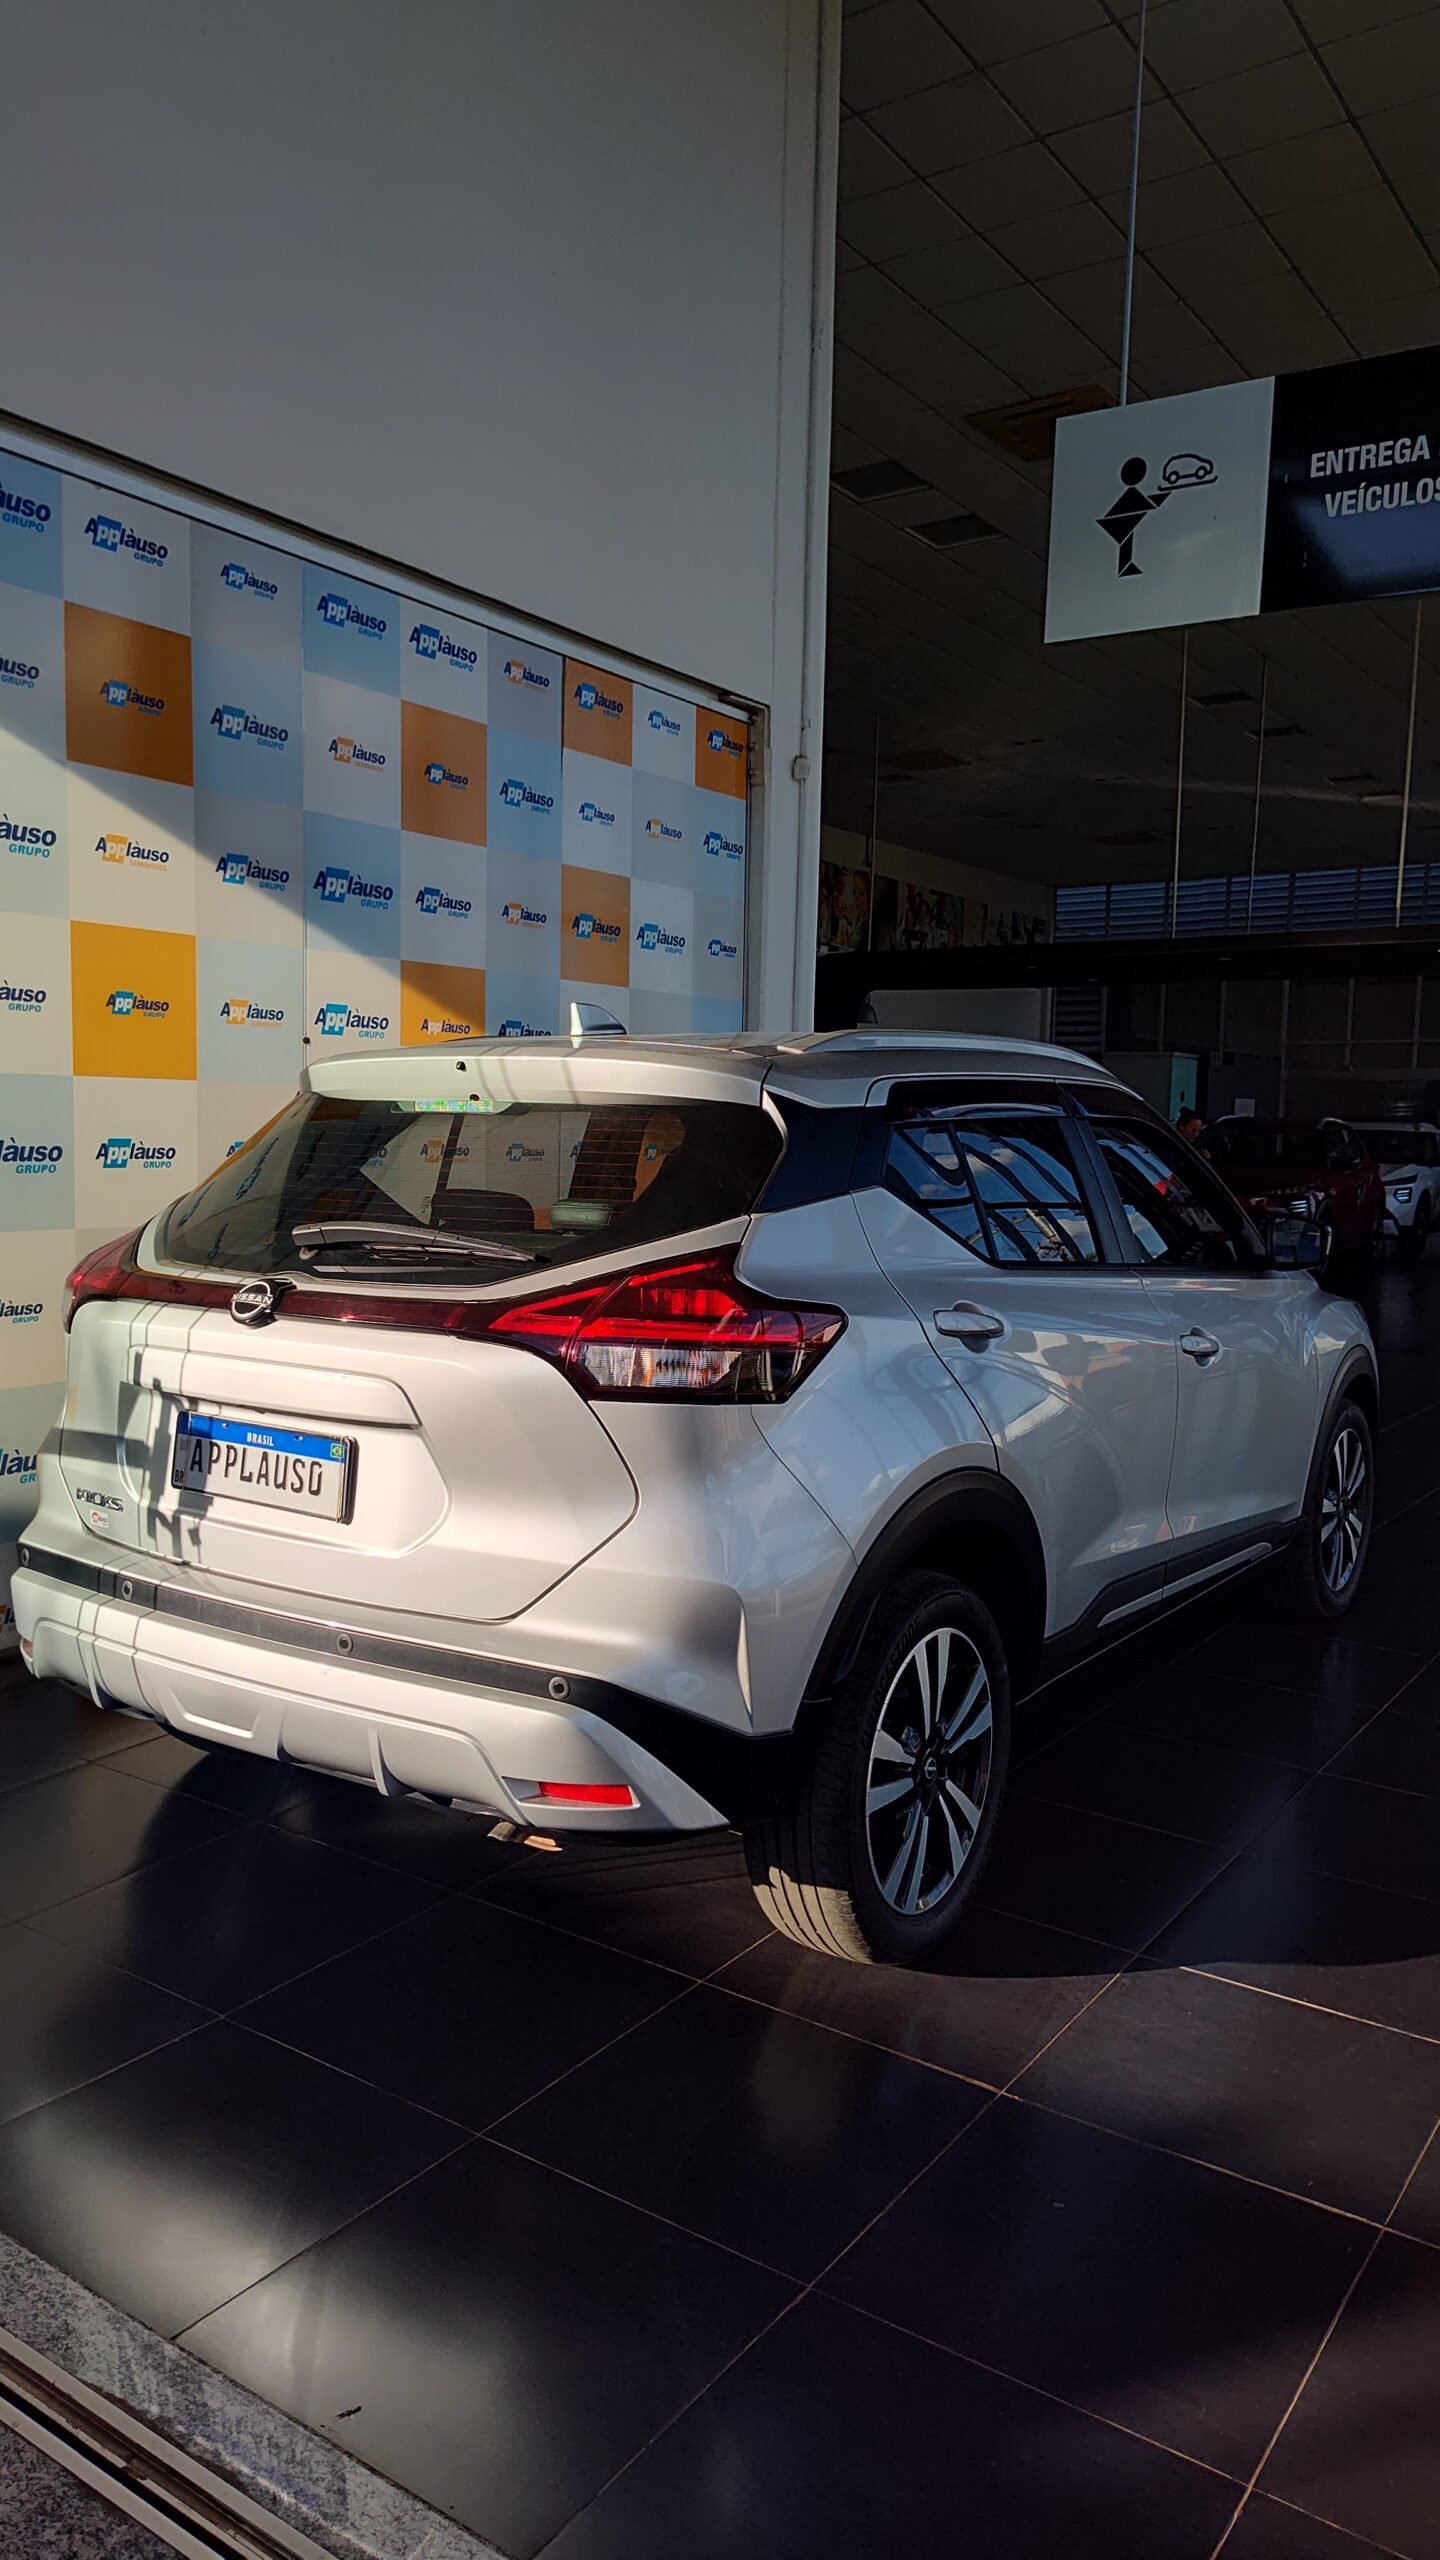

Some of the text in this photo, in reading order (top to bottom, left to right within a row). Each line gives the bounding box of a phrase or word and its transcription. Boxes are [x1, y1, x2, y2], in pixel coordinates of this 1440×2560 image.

[1310, 435, 1430, 478] ENTREGA
[2, 512, 45, 533] GRUPO
[84, 517, 168, 559] Applàuso
[134, 552, 163, 567] GRUPO
[220, 564, 278, 595] Applàuso
[317, 595, 387, 633] Applàuso
[358, 627, 383, 641] GRUPO
[409, 627, 478, 664] Applàuso
[449, 659, 474, 673] GRUPO
[1, 674, 34, 689] GRUPO
[210, 707, 289, 742] Applàuso
[257, 738, 285, 751] GRUPO
[500, 782, 554, 808] Applàuso
[9, 843, 50, 859] GRUPO
[215, 855, 290, 884] Applàuso
[258, 880, 286, 892] GRUPO
[313, 870, 394, 901] Applàuso
[360, 898, 389, 910] GRUPO
[415, 890, 472, 912] Applàuso
[8, 1002, 42, 1013] GRUPO
[106, 994, 170, 1014] Applàuso
[314, 1007, 389, 1031] Applàuso
[358, 1030, 385, 1039] GRUPO
[96, 1141, 176, 1165] Applàuso
[16, 1164, 57, 1174] GRUPO
[143, 1161, 172, 1169] GRUPO
[231, 1292, 273, 1305] NISSAN
[12, 1315, 39, 1324] GRUPO
[247, 1432, 274, 1447] BRASIL
[175, 1469, 184, 1483] BR
[190, 1439, 322, 1496] APPLAUSO
[76, 1487, 124, 1512] KICKS
